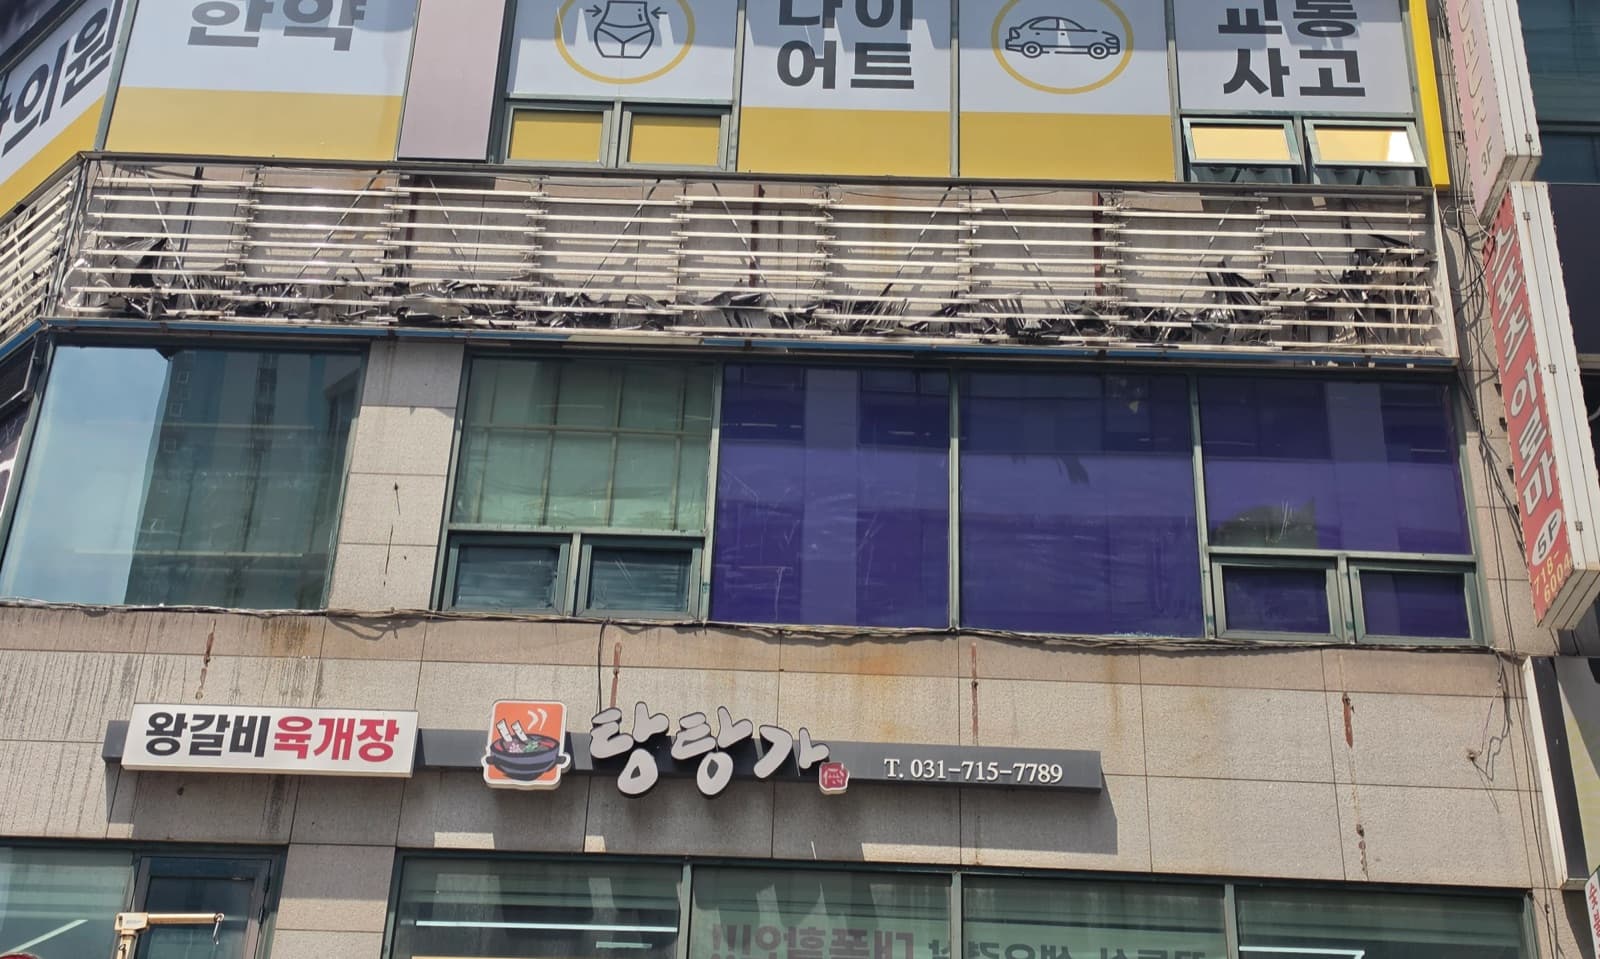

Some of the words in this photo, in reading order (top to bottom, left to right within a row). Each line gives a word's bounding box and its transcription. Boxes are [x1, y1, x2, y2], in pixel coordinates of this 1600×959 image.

[0, 0, 123, 157] 의원
[777, 40, 914, 89] 어트
[1223, 48, 1366, 97] 사고
[1492, 226, 1530, 373] 스포츠
[1511, 357, 1553, 515] 아로마
[589, 701, 830, 795] 탕탕가
[884, 758, 904, 778] T.
[910, 759, 1063, 783] 031-715-7789
